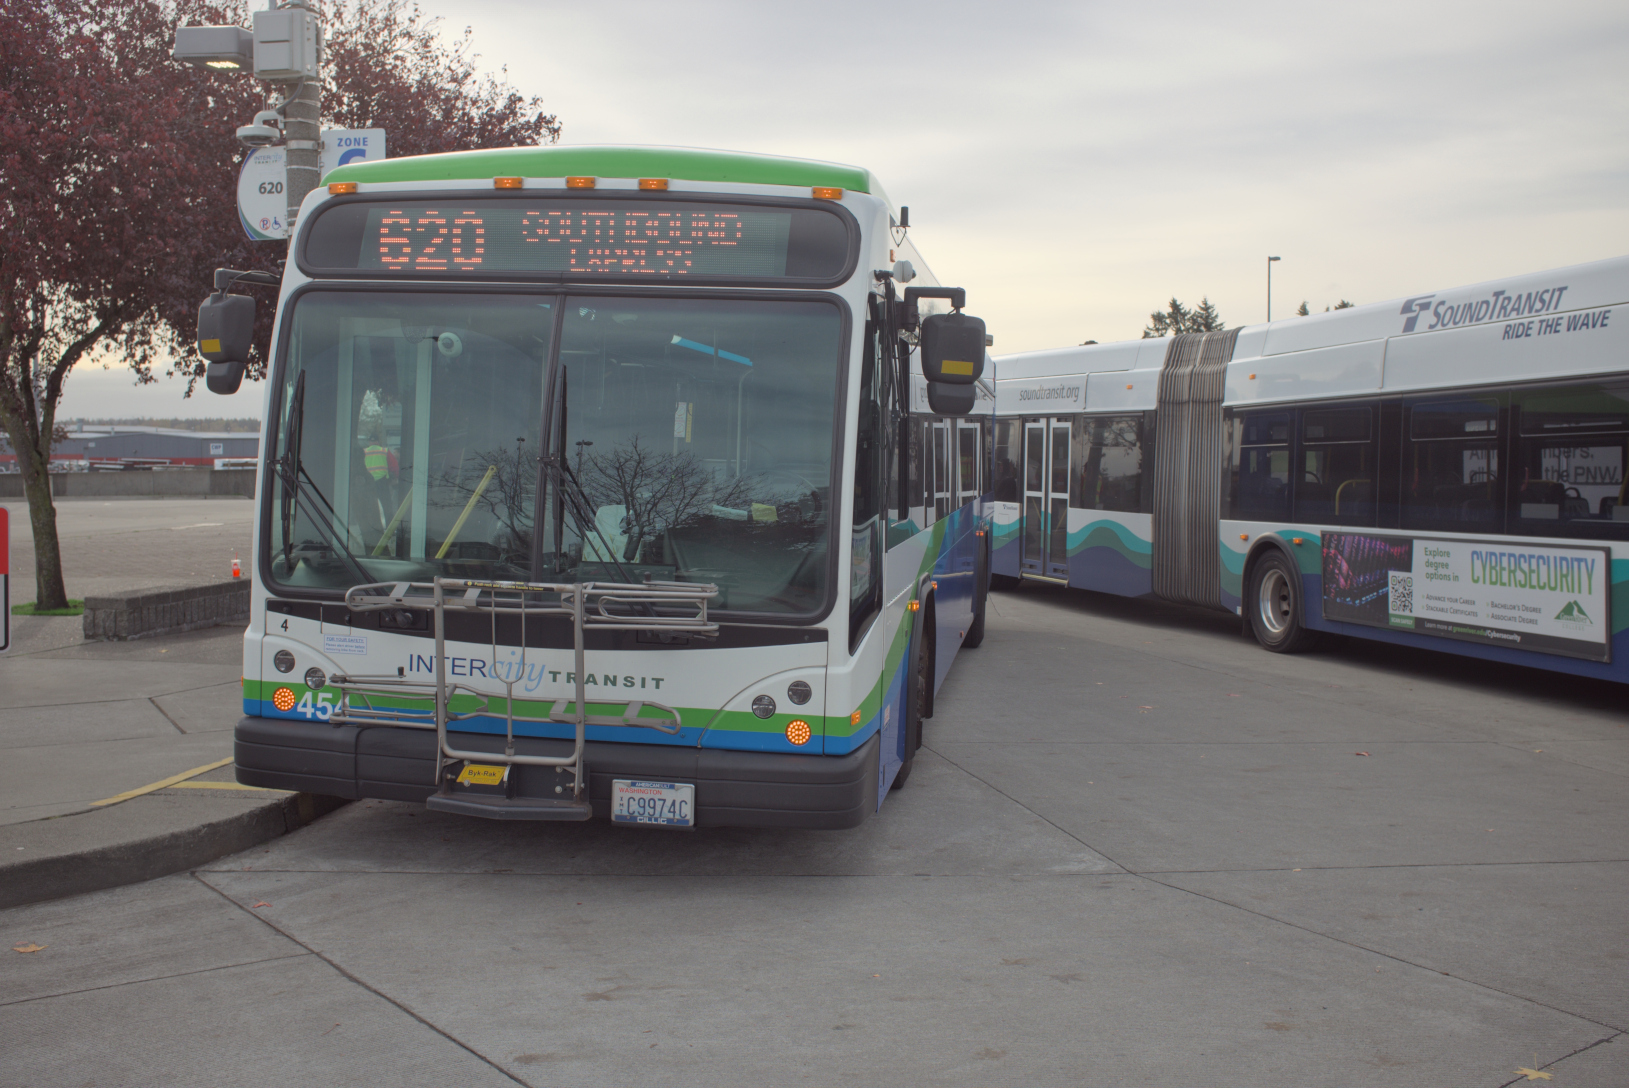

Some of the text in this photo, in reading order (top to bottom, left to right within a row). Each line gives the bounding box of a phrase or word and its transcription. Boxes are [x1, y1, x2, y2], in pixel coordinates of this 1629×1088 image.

[337, 137, 369, 147] ZONE
[258, 181, 284, 195] 620
[380, 211, 485, 270] 620
[1502, 309, 1612, 341] RIDE THE WAVE
[1019, 383, 1080, 403] soundtransit.org
[1424, 547, 1451, 559] Explore
[1424, 558, 1449, 570] degree
[1425, 570, 1460, 582] options in
[1470, 550, 1596, 595] CYBERSECURITY
[1425, 593, 1446, 603] ADVANCE
[1459, 597, 1476, 606] CAREER
[1425, 604, 1479, 618] STACKABLE CERTIFICATES
[1490, 601, 1542, 614] BACHELOR'S DEGREE
[280, 618, 289, 632] 4
[1424, 620, 1436, 629] Learn
[1490, 612, 1539, 626] ASSOCIATE DEGREE
[548, 671, 665, 690] TRANSIT
[468, 769, 497, 778] Byk-Rak
[618, 787, 663, 796] WASHINGTON
[627, 796, 688, 819] C9974C
[637, 816, 668, 825] GILLIG
